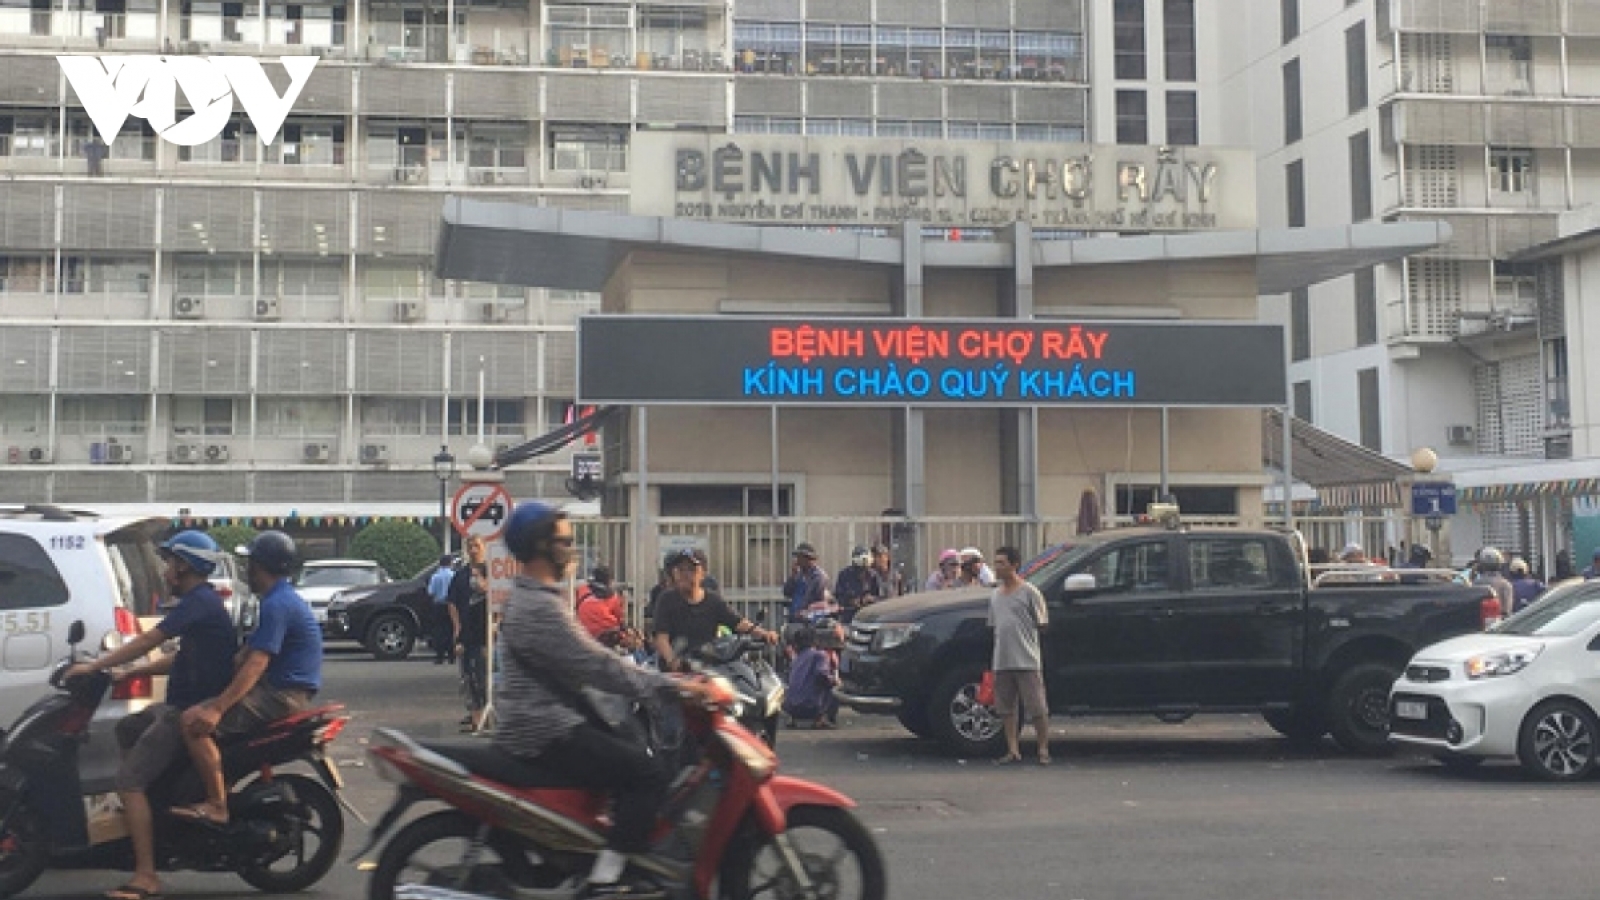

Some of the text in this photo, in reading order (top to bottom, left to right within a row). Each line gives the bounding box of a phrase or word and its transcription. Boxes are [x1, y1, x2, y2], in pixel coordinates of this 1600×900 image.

[675, 142, 1219, 208] BỆNH VIỆN CHỢ RẪY
[770, 325, 865, 364] BỆNH
[872, 325, 949, 364] VIỆN
[957, 329, 1034, 365] CHỢ
[744, 360, 1135, 398] KÍNH CHÀO QUÝ KHÁCH
[49, 535, 85, 550] 1152
[0, 611, 51, 631] 5.51
